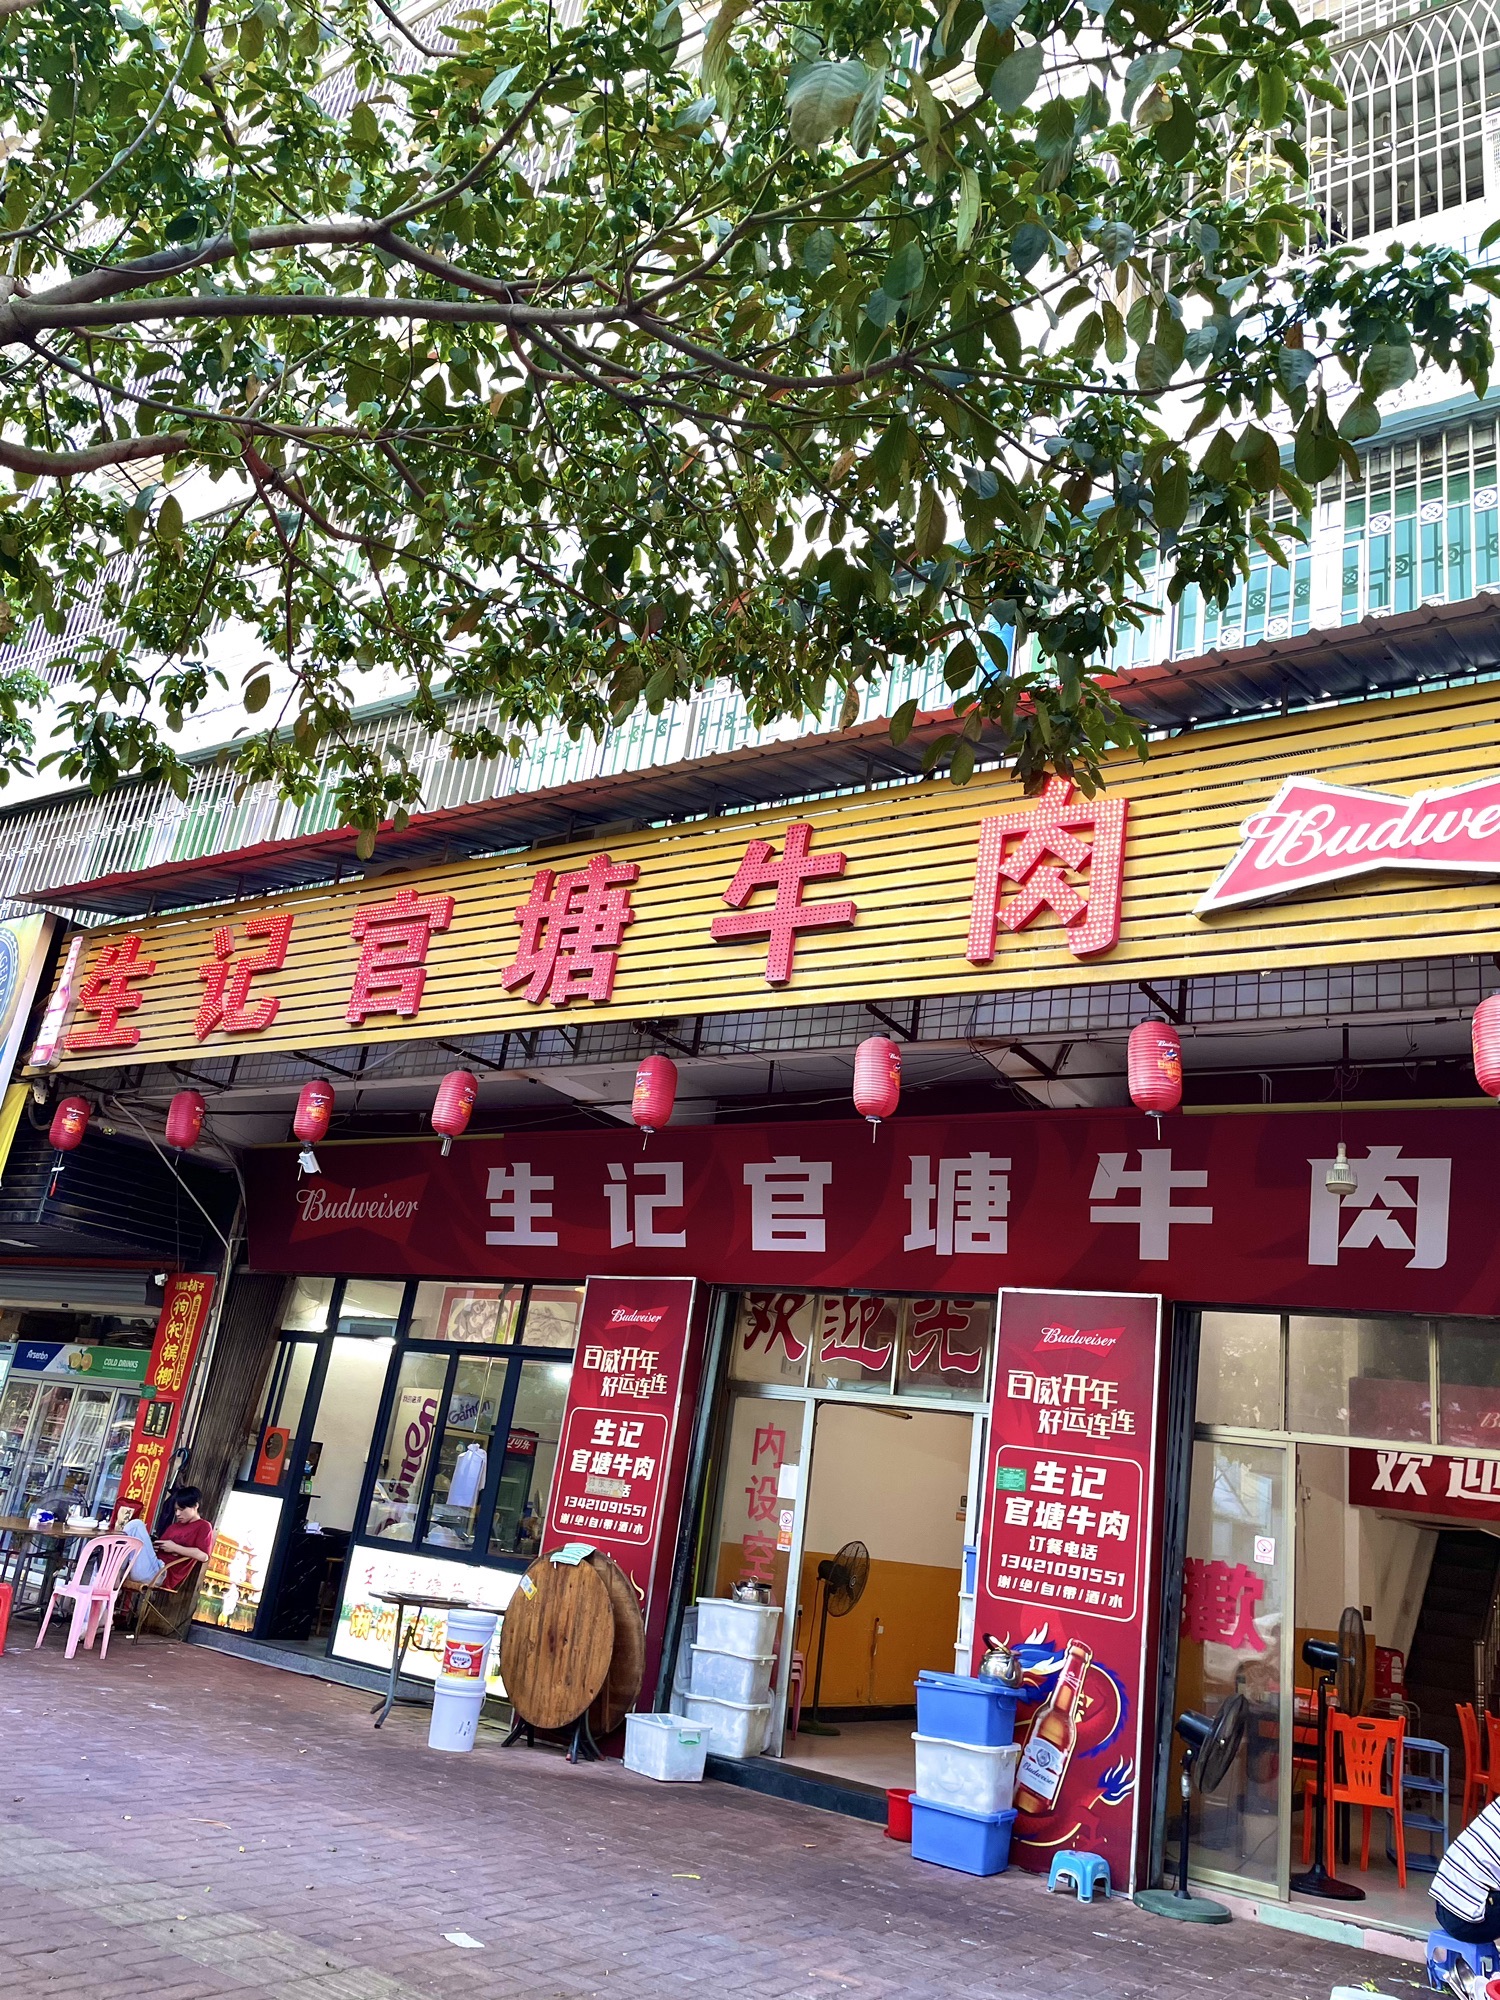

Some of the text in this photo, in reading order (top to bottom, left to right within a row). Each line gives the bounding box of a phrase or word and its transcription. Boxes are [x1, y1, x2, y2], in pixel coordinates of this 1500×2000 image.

[64, 777, 1129, 1048] 生记官塘牛肉
[296, 1188, 418, 1221] Budweiser
[485, 1145, 1452, 1269] 生记官塘牛肉
[611, 1308, 662, 1323] Budweiser
[1041, 1327, 1117, 1347] Budweiser
[103, 1358, 119, 1367] COLD
[119, 1360, 138, 1369] DRINKS
[583, 1345, 659, 1375] 百威开年
[600, 1373, 668, 1399] 好运连连
[1007, 1369, 1118, 1410] 百威开年
[590, 1418, 644, 1449] 生记
[1037, 1406, 1136, 1440] 好运连连
[570, 1448, 655, 1481] 官塘牛肉
[1030, 1460, 1107, 1500] 生记
[564, 1495, 647, 1517] 13421091551
[1004, 1496, 1130, 1541] 官塘牛肉
[1029, 1535, 1098, 1561] 订餐电话
[1000, 1553, 1125, 1587] 13421091551
[1022, 1761, 1055, 1785] Budweiser
